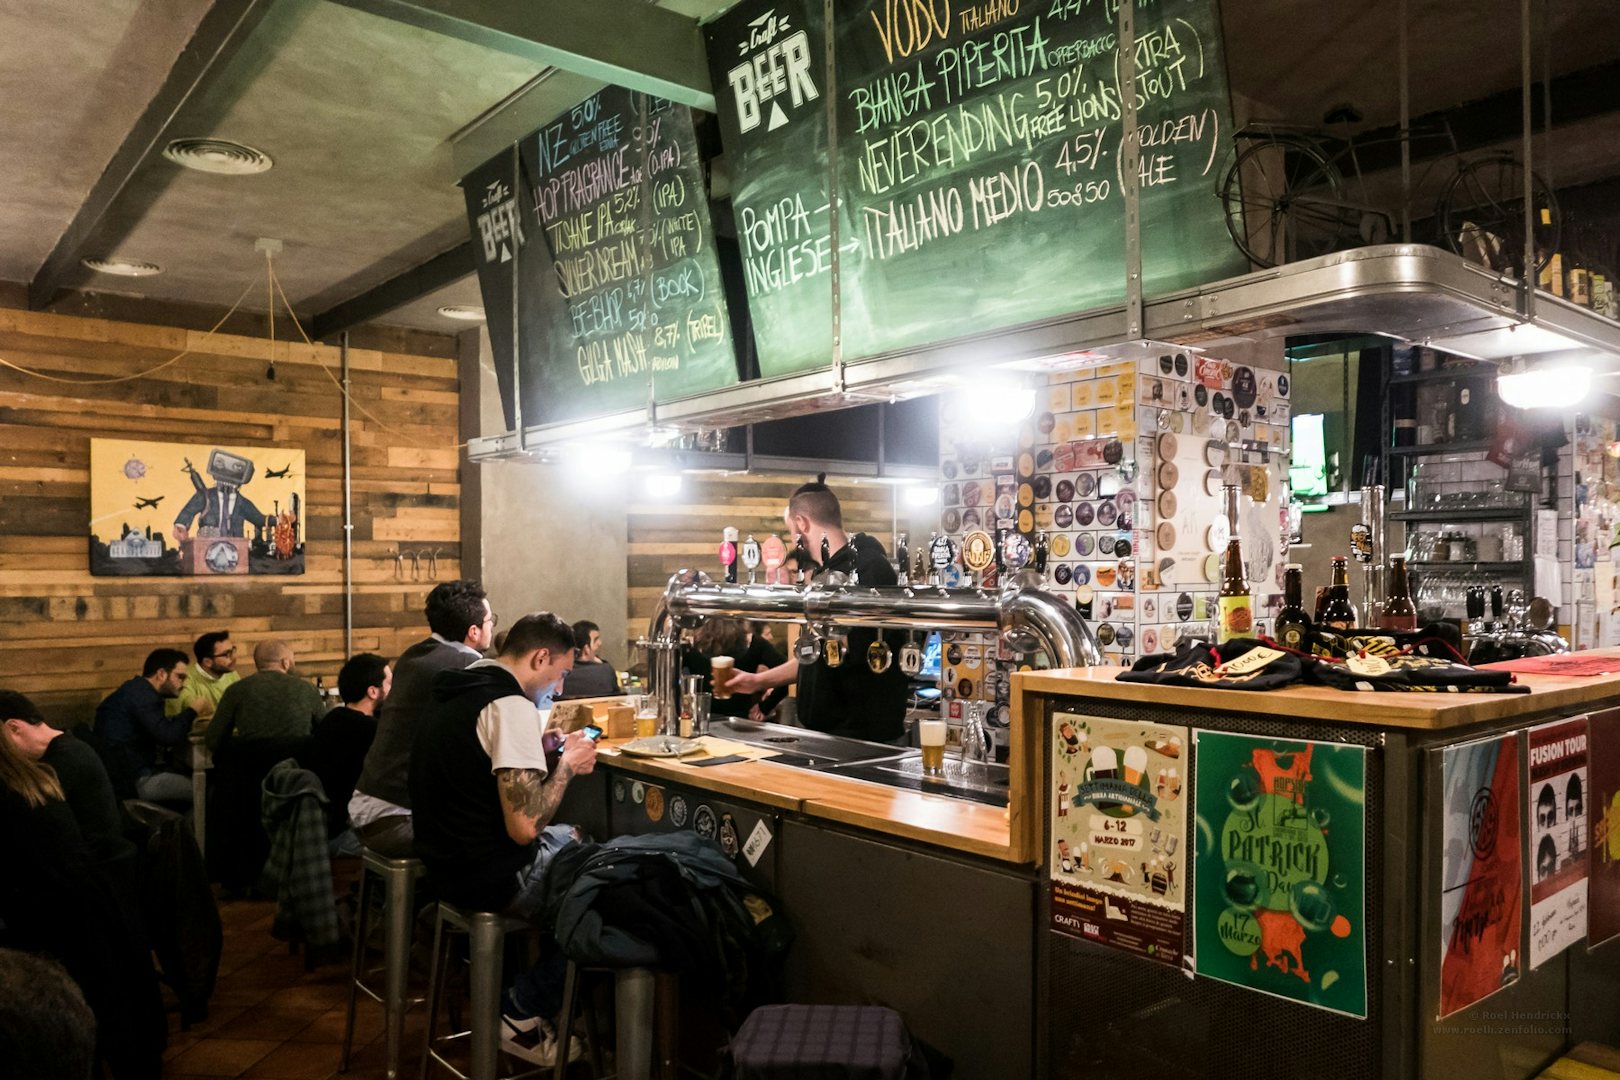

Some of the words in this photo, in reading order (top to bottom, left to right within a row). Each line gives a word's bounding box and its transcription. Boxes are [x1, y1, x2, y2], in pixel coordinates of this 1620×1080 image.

[750, 15, 777, 50] Craft
[935, 16, 1050, 104] PIPERITA
[727, 29, 820, 134] BEER
[538, 122, 571, 178] NZ
[858, 93, 1034, 195] NEVERENDING
[1030, 104, 1067, 140] FREE
[477, 198, 526, 263] BEER
[741, 192, 812, 259] POMPA
[863, 186, 965, 261] ITALIANO
[968, 161, 1045, 231] MEDIO
[745, 234, 833, 298] INGLESE
[1530, 740, 1564, 767] FUSION
[1564, 734, 1587, 756] TOUR
[1094, 834, 1119, 846] MARZO
[1228, 829, 1321, 881] PATRICK
[1219, 923, 1261, 945] Marzo
[1234, 913, 1250, 932] 17
